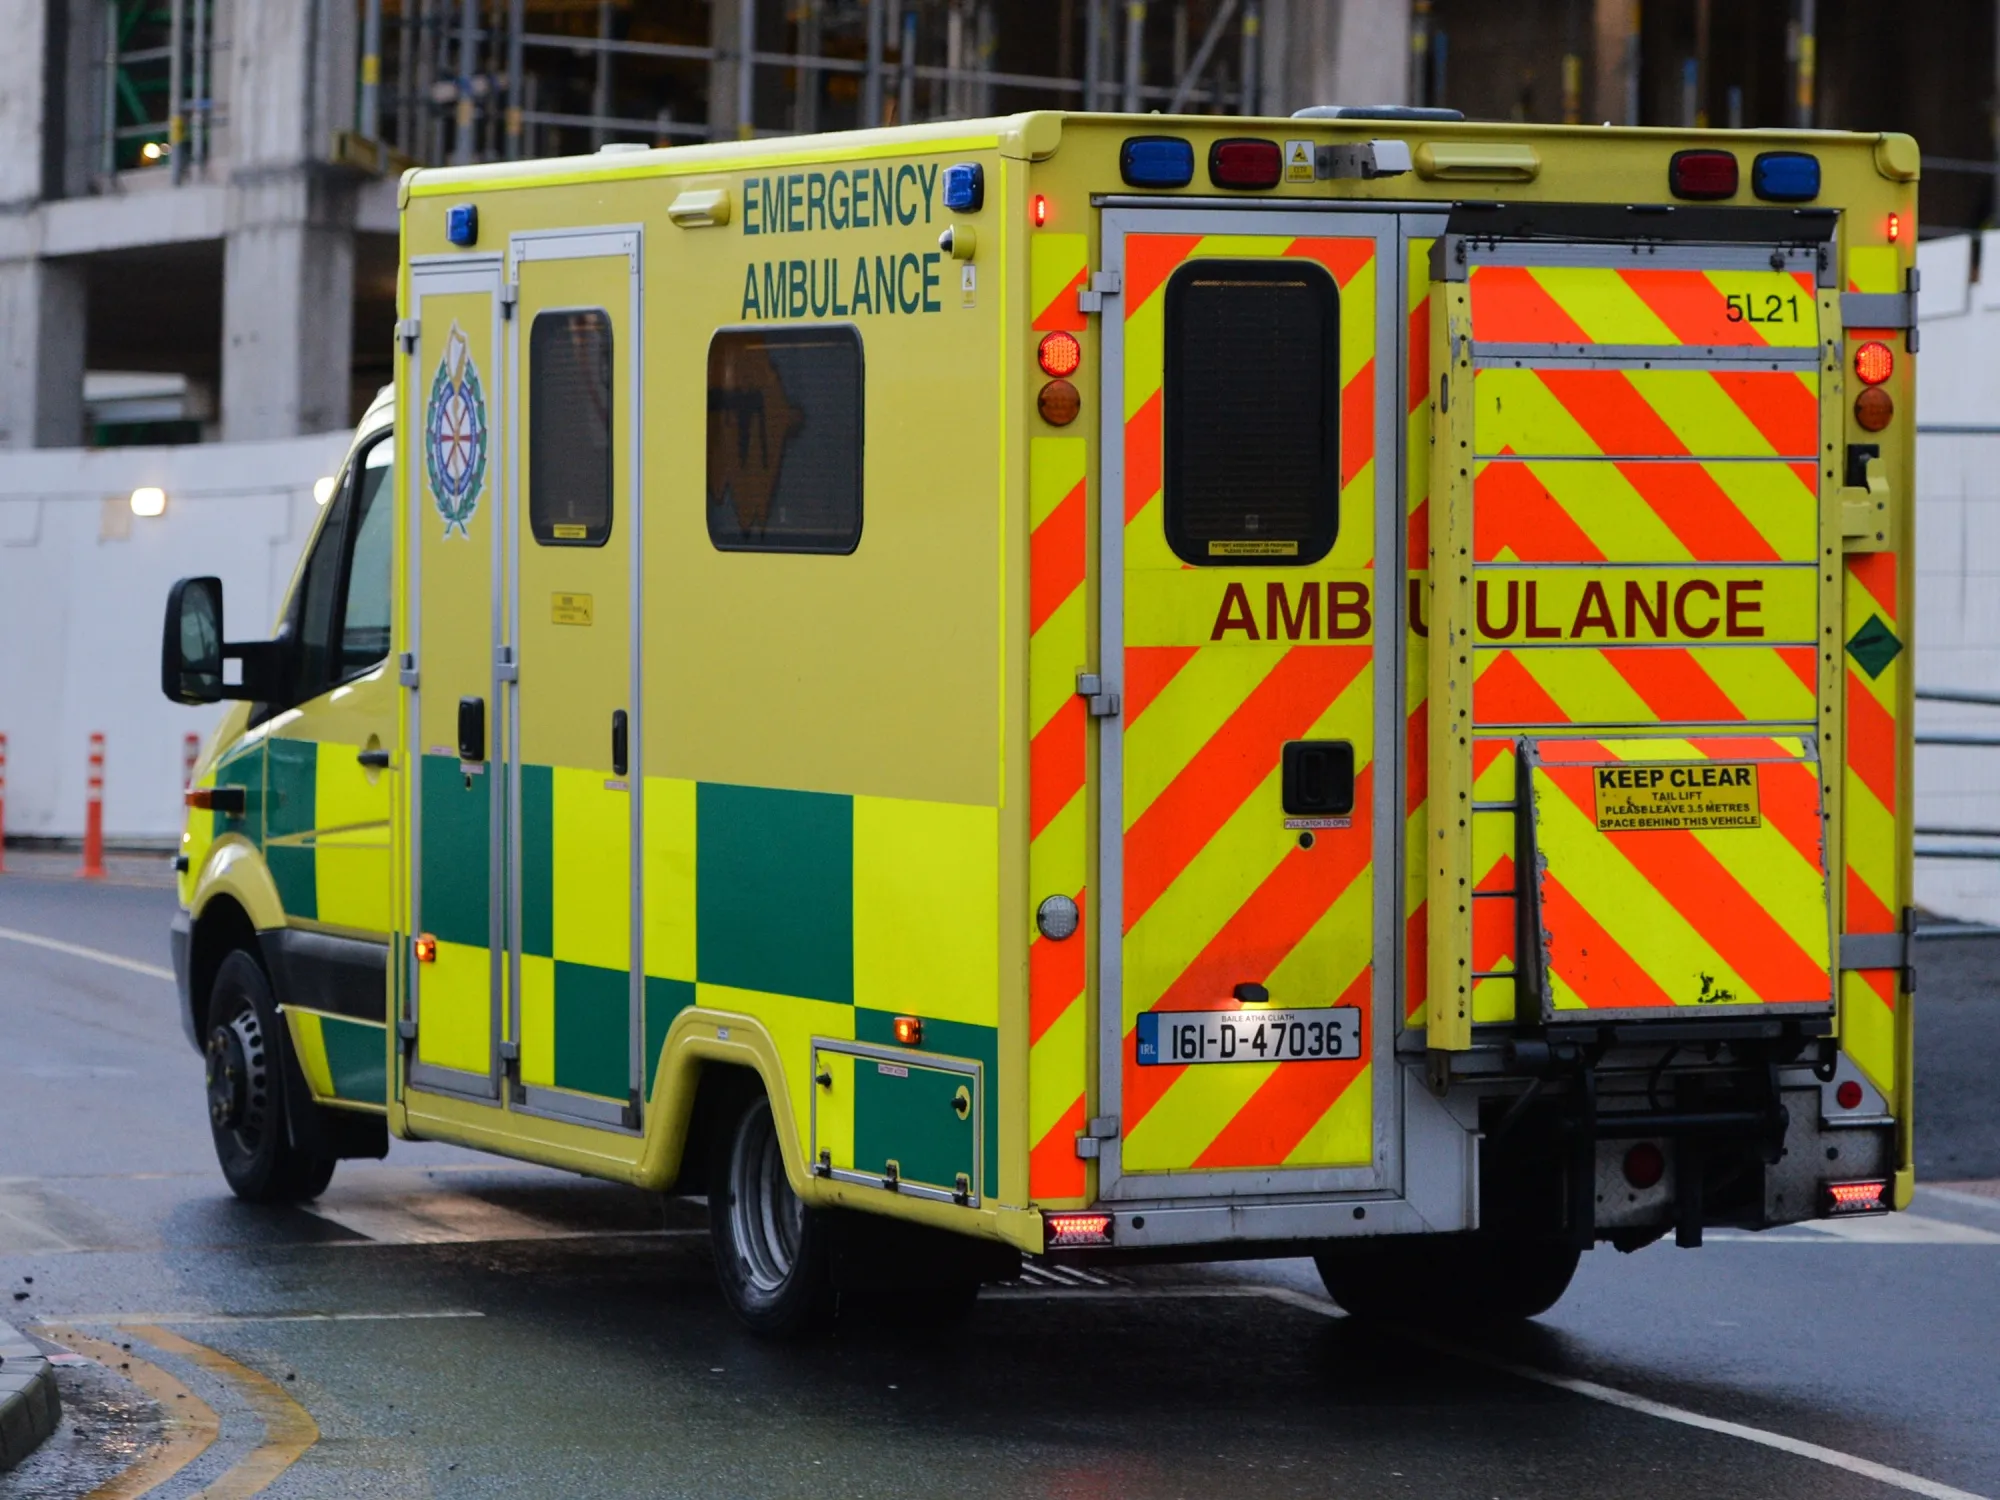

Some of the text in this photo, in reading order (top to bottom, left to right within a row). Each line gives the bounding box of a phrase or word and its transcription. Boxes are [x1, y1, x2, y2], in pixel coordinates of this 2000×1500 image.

[743, 163, 938, 236] EMERGENCY
[741, 252, 941, 320] AMBULANCE
[1726, 293, 1798, 322] 5L21
[1210, 581, 1371, 641] AMB
[1599, 768, 1751, 789] KEEP CLEAR
[1652, 791, 1702, 801] TAIL LIFT
[1605, 802, 1750, 815] PLEASE LEAVE 3.5 METRES
[1600, 815, 1758, 829] SPACE BEHIND THIS VEHICLE
[1221, 1015, 1244, 1023] BAILE
[1268, 1013, 1295, 1021] CLIATH
[1141, 1043, 1156, 1055] IRL
[1172, 1021, 1342, 1059] 161-D-47036
